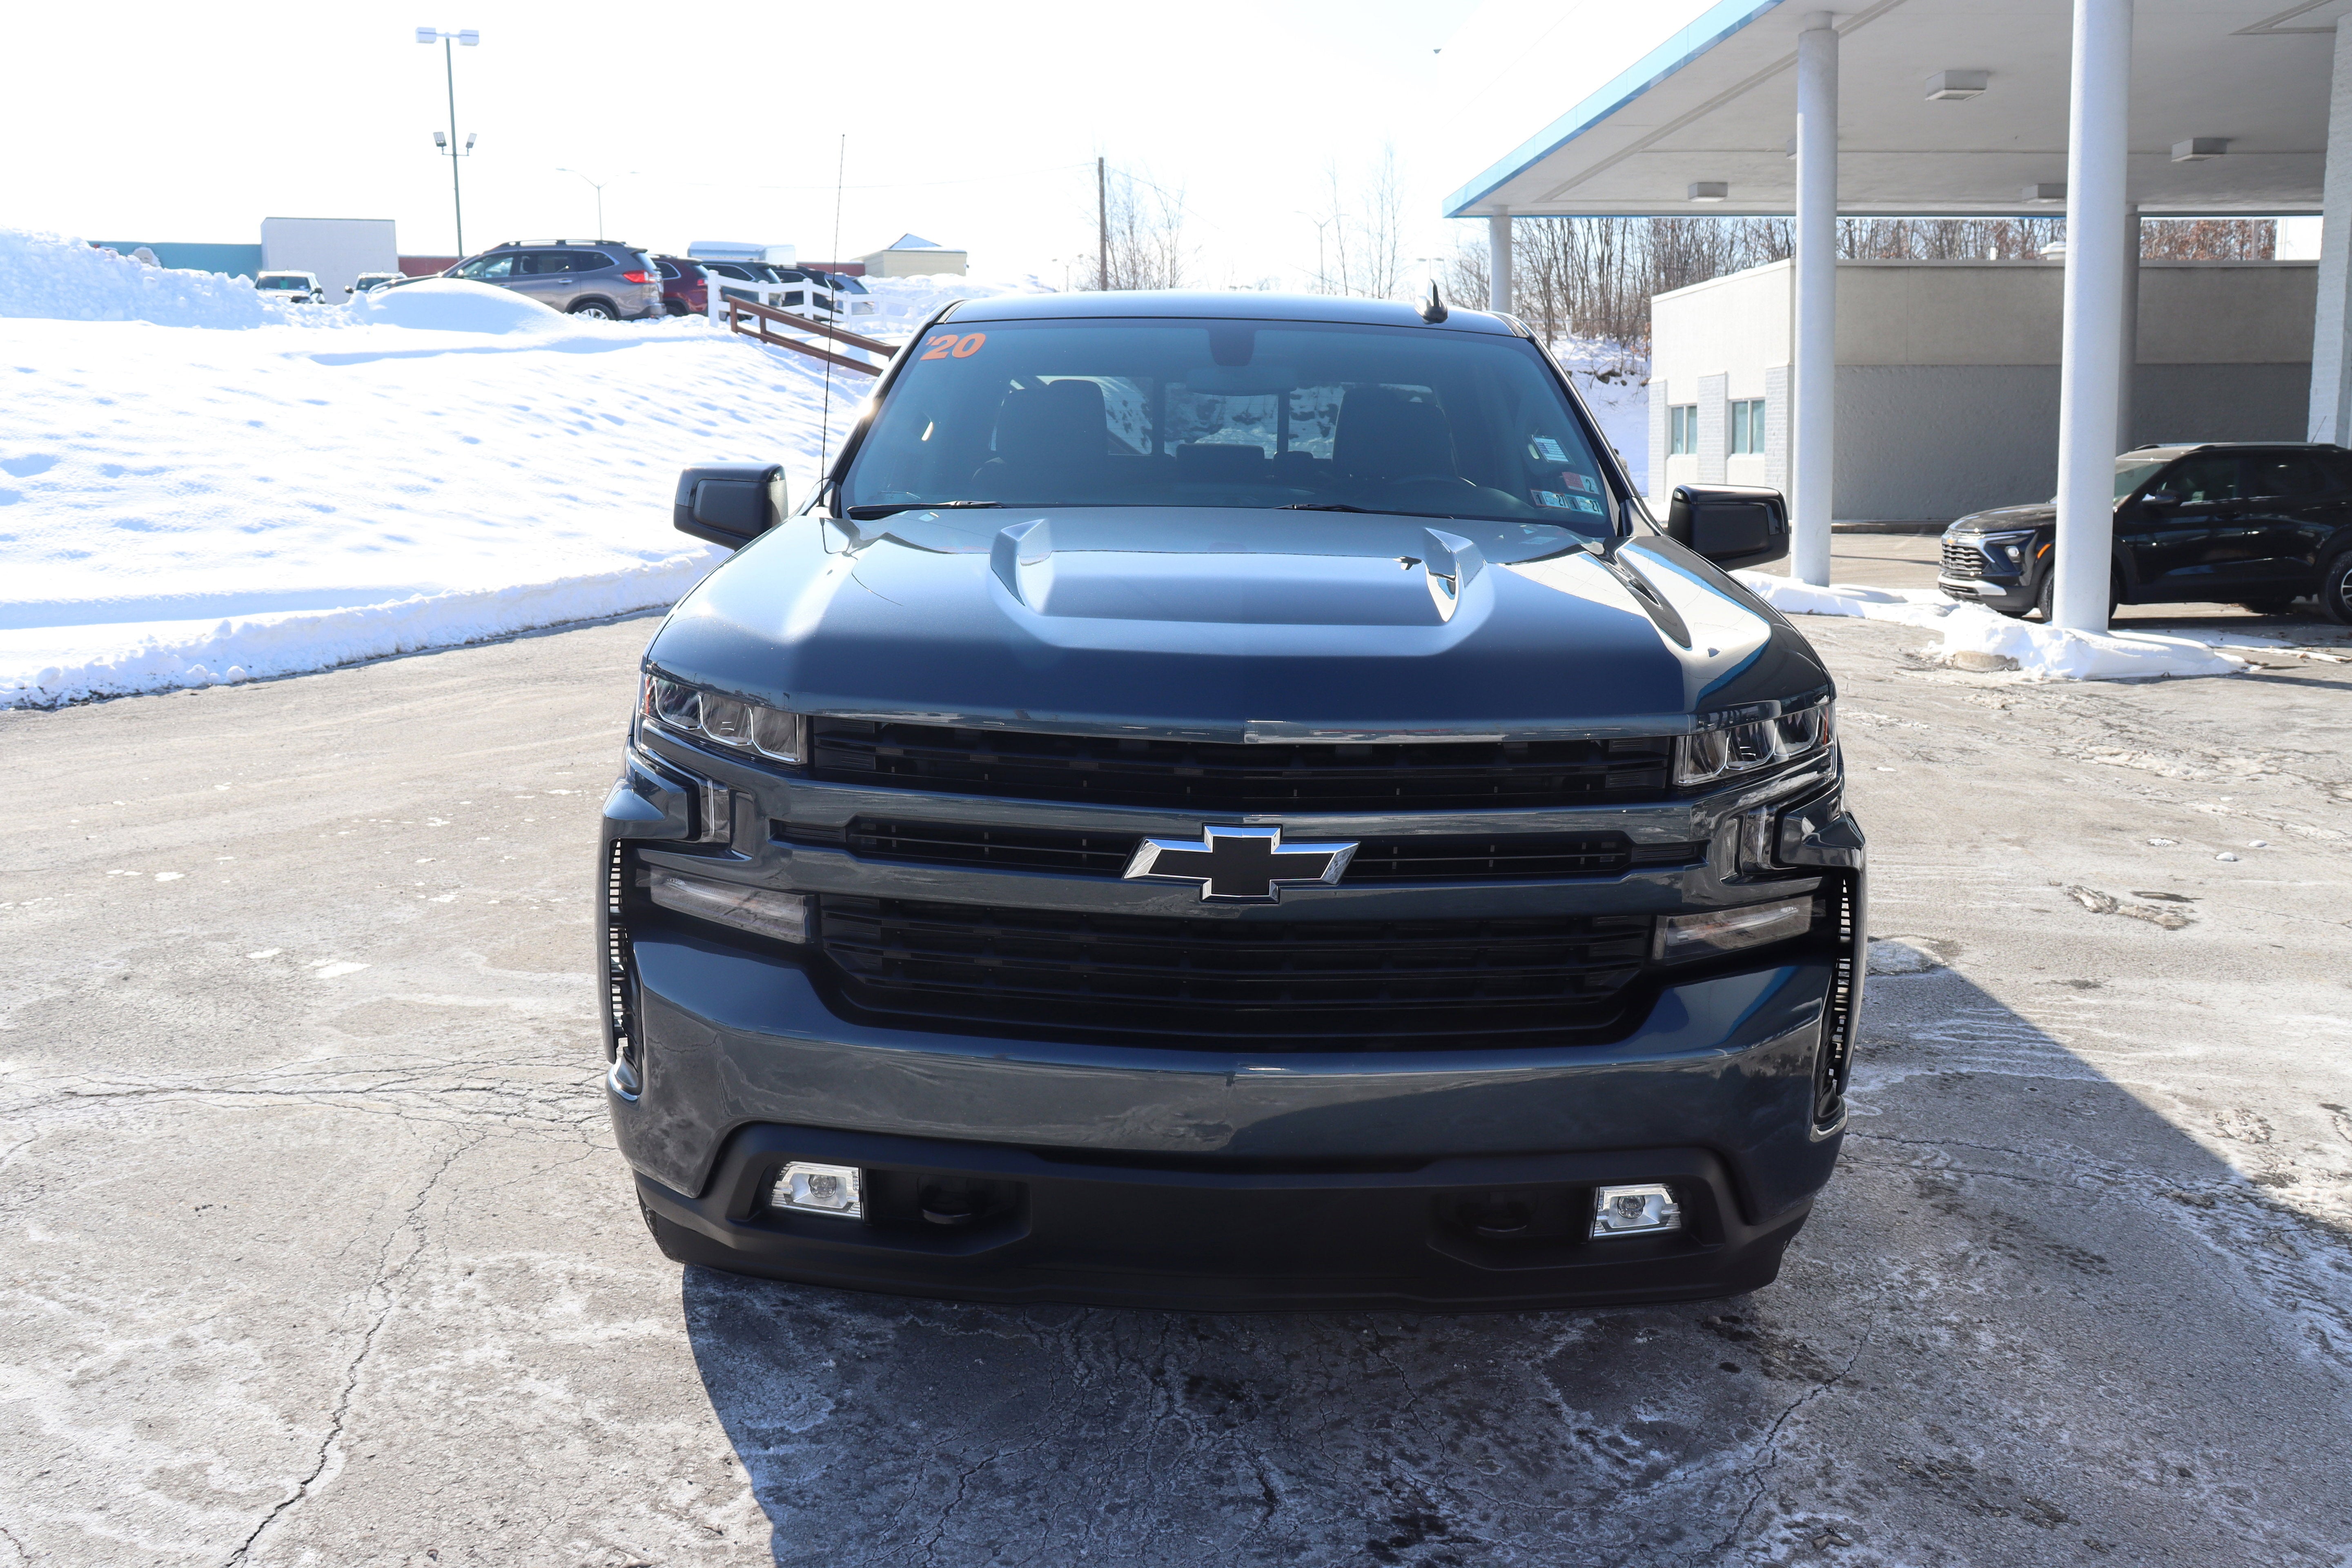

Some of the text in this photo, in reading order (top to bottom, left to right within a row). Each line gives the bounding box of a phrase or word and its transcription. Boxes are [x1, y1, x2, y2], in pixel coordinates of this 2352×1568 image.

[1585, 478, 1595, 492] 2
[1536, 494, 1566, 507] 1 27
[1570, 499, 1599, 512] 1 27
